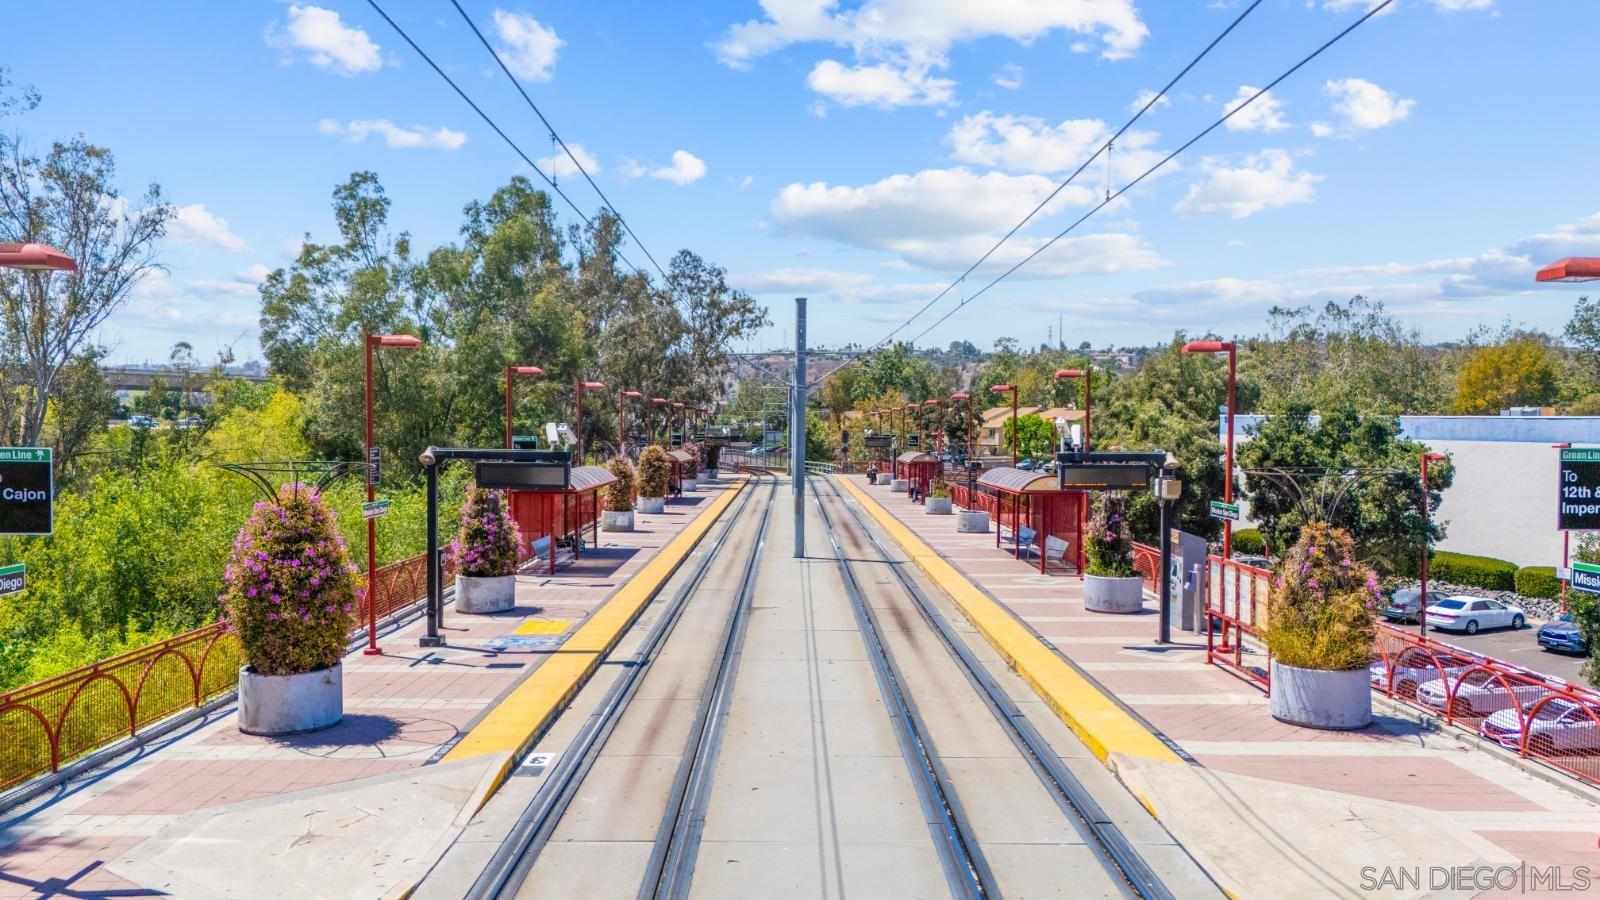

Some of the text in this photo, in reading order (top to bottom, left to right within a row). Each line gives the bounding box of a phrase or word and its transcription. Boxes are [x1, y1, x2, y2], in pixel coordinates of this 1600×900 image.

[12, 451, 32, 459] Line
[1562, 450, 1587, 459] Green
[1562, 470, 1577, 482] To
[3, 487, 46, 502] Cajon
[1562, 486, 1591, 498] 12th
